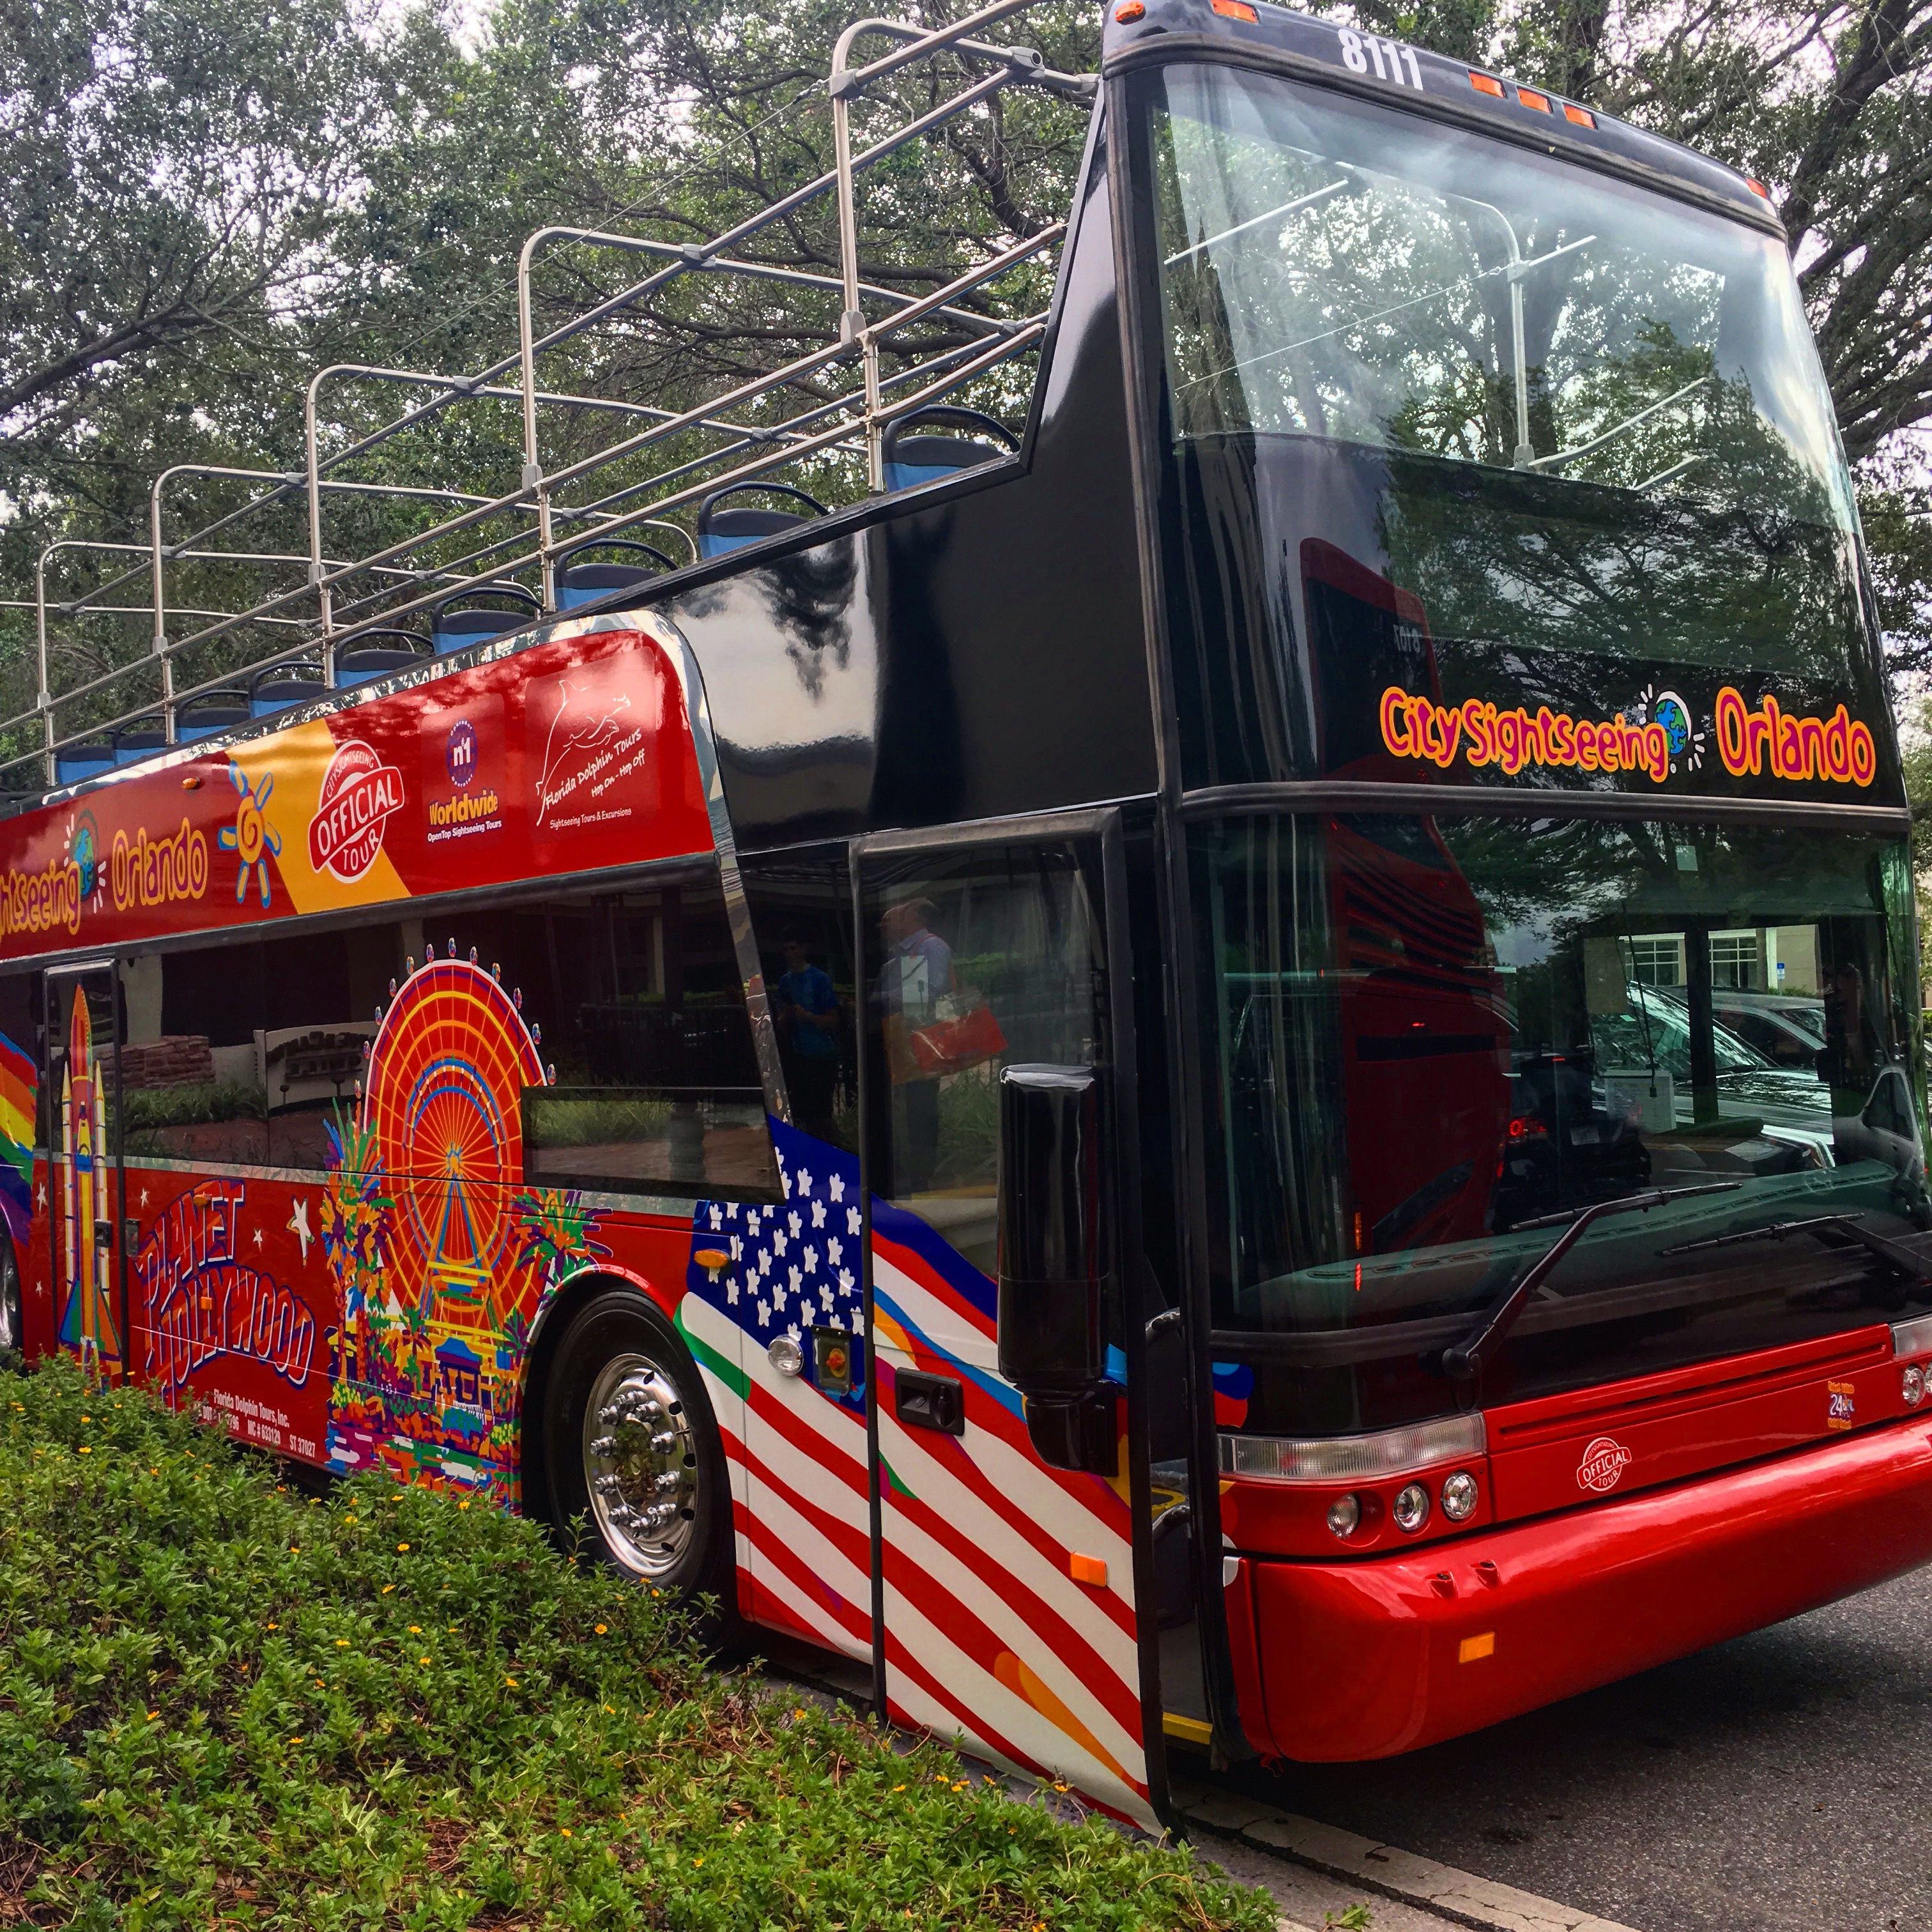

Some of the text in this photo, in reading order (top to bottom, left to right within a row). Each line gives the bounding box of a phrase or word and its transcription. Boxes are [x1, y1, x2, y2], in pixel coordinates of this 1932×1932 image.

[1338, 29, 1423, 91] 8111
[1716, 686, 1876, 787] Orlando
[546, 728, 642, 810] Florida Dolphin Tours
[591, 783, 604, 798] Hop
[604, 776, 615, 788] On
[619, 762, 632, 776] Hop
[632, 747, 645, 767] Off
[318, 773, 399, 857] OFFICIAL
[429, 789, 498, 826] Worldwide
[452, 823, 485, 838] Sightseeing
[486, 820, 502, 830] Tours
[549, 808, 632, 831] Sightseeing Tours & Excursions
[112, 817, 208, 911] Orlando
[342, 828, 379, 871] TOUR
[135, 1177, 246, 1315] PLANET
[142, 1263, 316, 1409] HOLLYWOOD
[213, 1388, 234, 1409] Florida
[234, 1395, 258, 1418] Dolphin
[258, 1402, 277, 1427] Tours,
[277, 1409, 290, 1428] Inc.
[1830, 1393, 1843, 1416] 24
[289, 1434, 297, 1452] ST
[297, 1437, 316, 1458] 37027
[1583, 1450, 1629, 1482] OFFICIAL
[1598, 1469, 1619, 1487] TOUR
